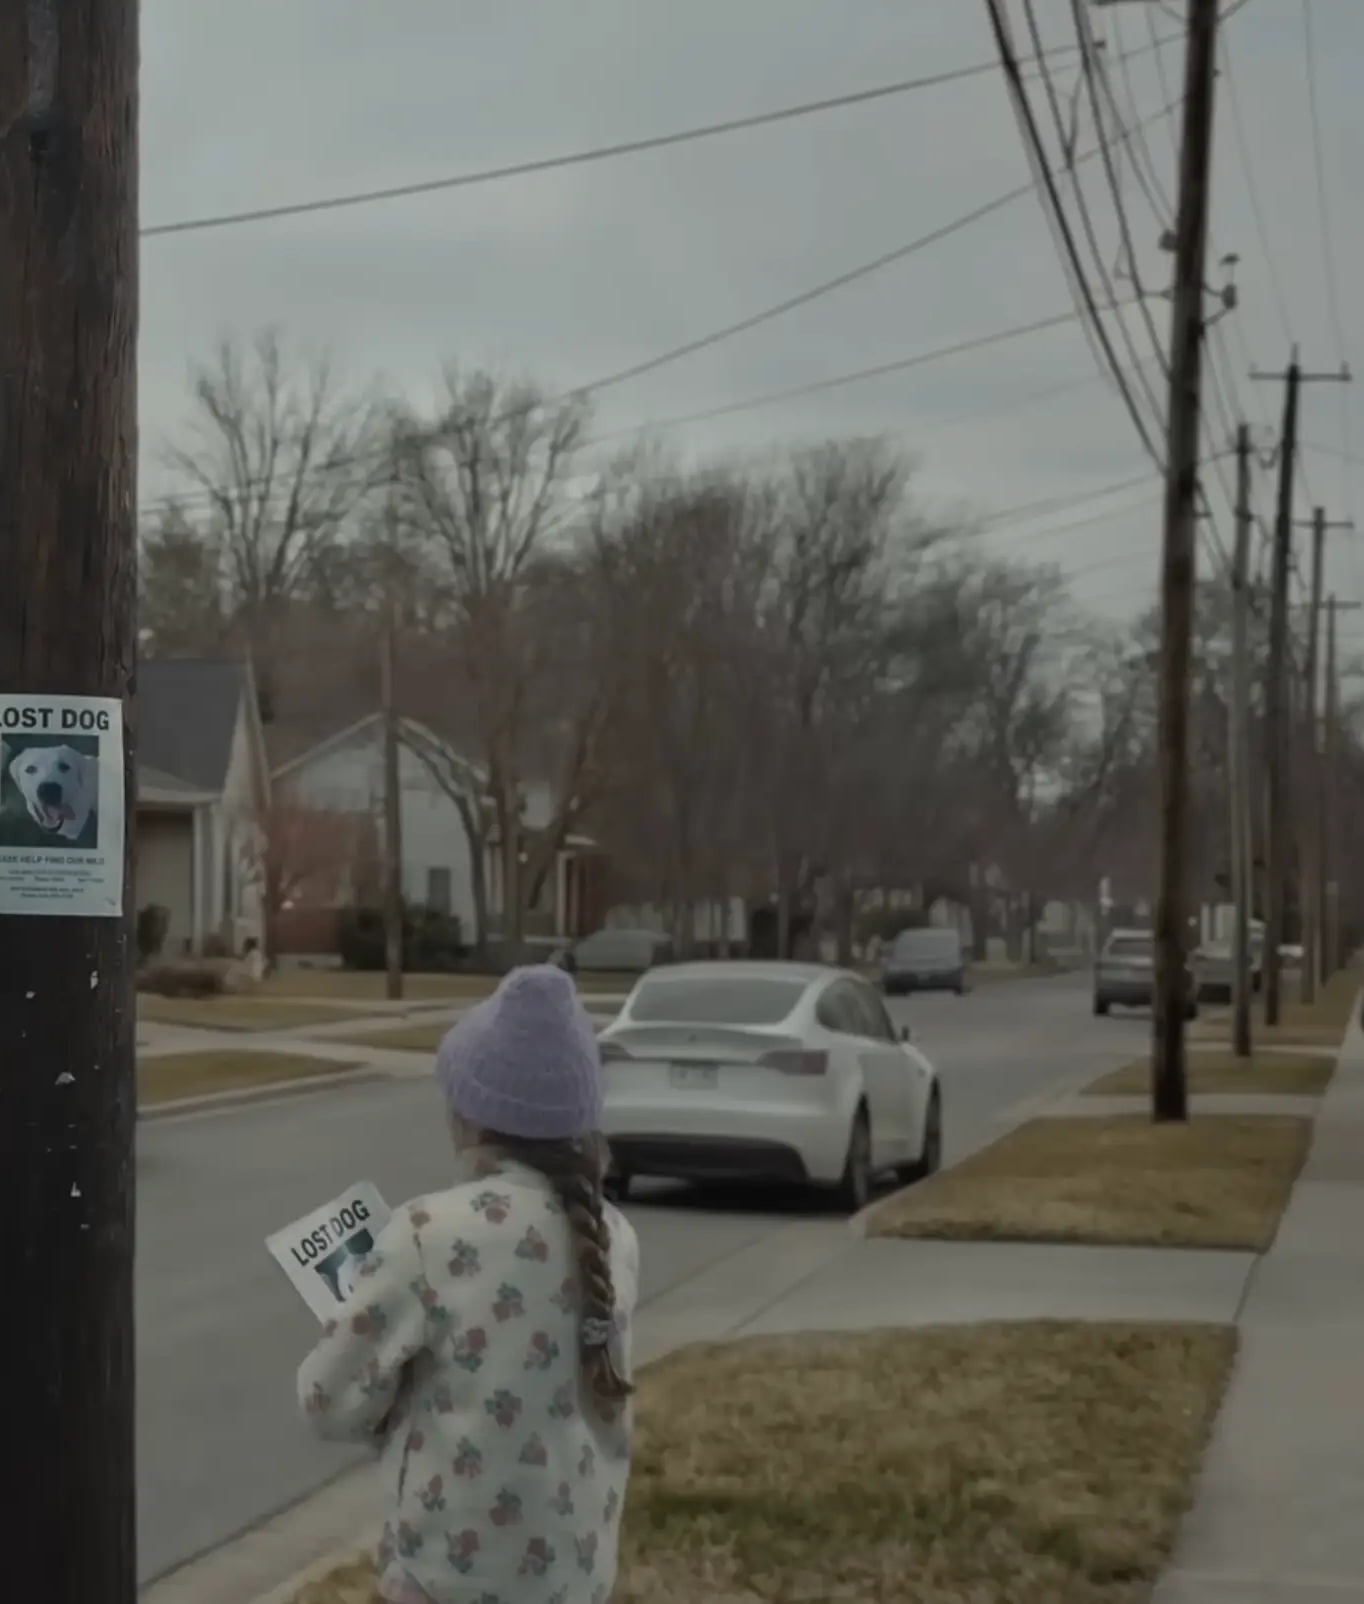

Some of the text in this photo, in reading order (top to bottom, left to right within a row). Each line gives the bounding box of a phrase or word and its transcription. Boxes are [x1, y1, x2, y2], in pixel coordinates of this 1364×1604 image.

[61, 707, 110, 731] DOG
[20, 854, 44, 865] HELP
[66, 855, 84, 866] OUR
[290, 1199, 371, 1267] LOST DOG
